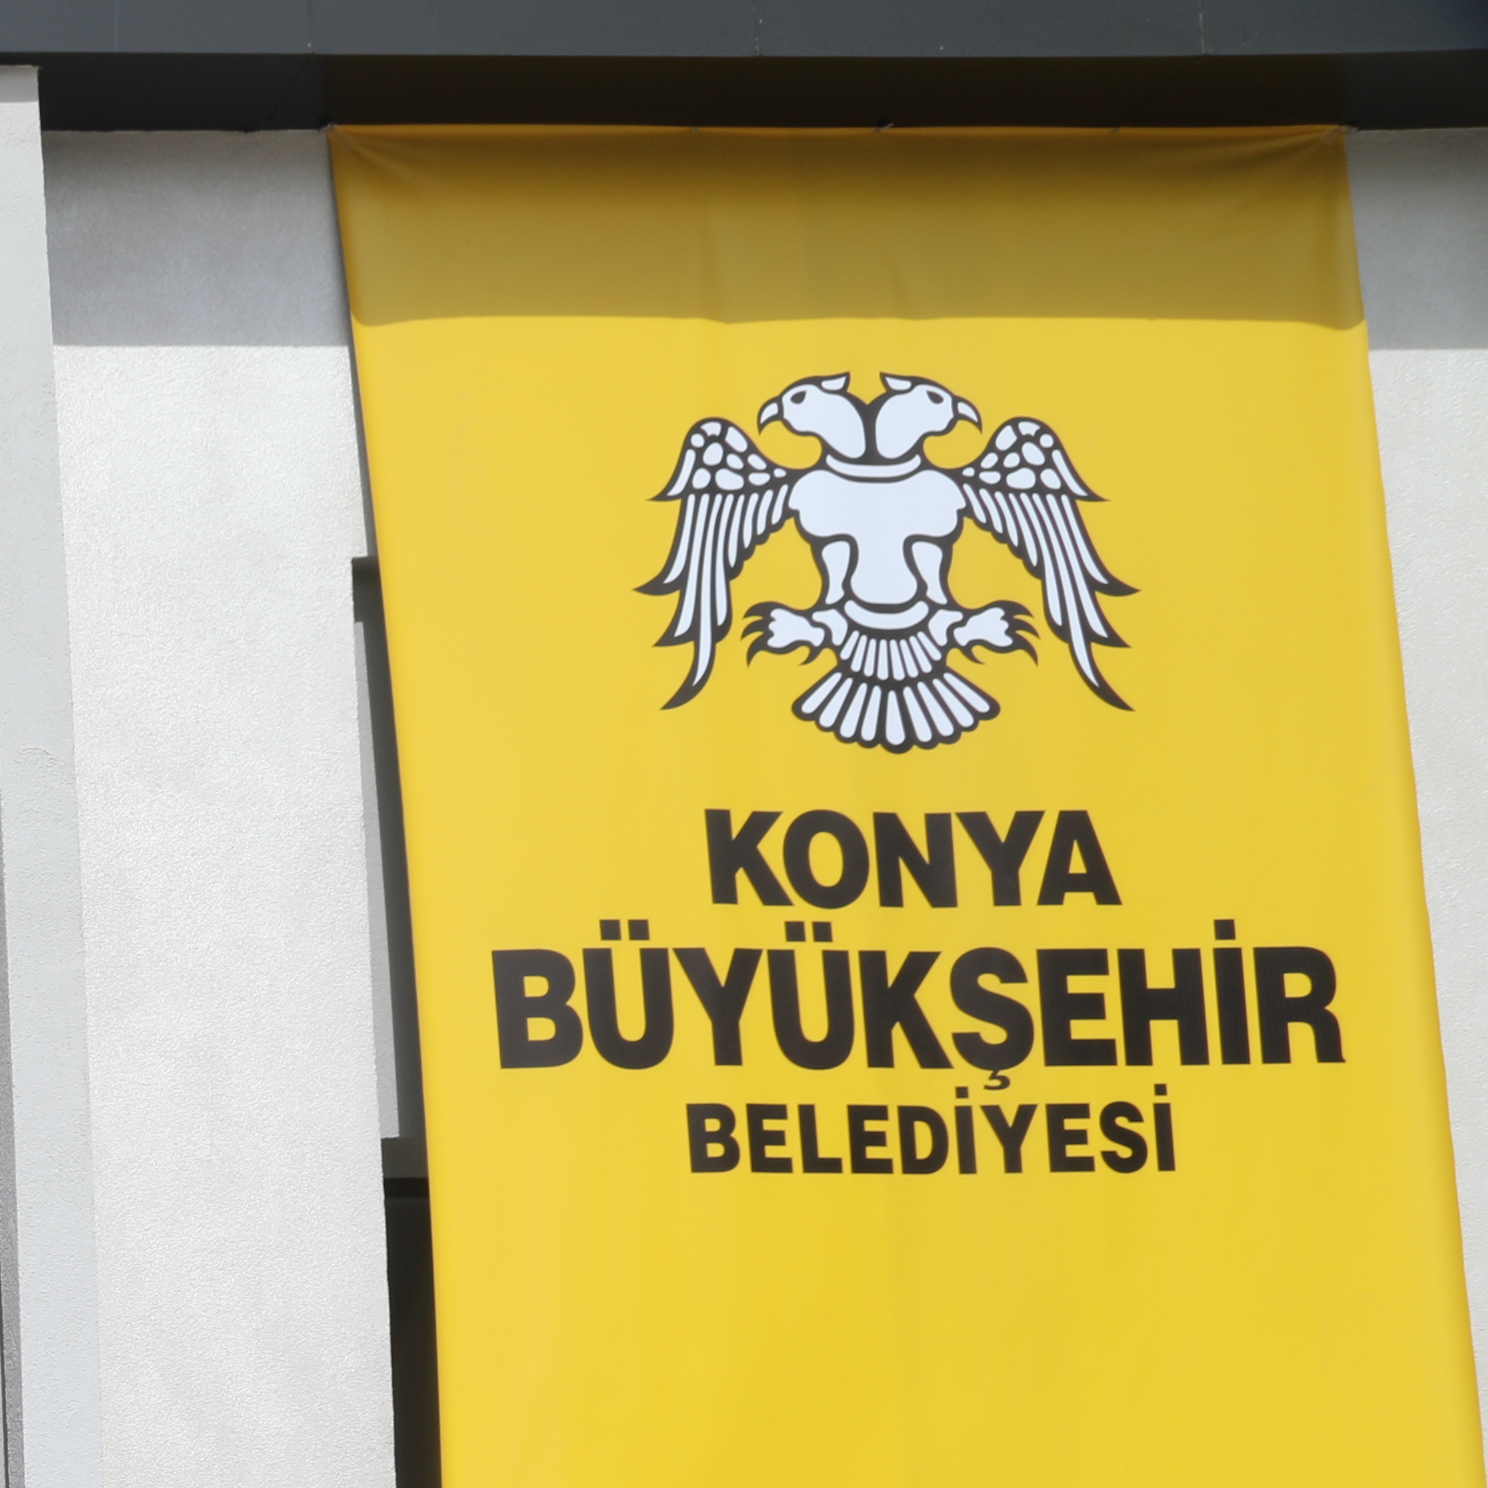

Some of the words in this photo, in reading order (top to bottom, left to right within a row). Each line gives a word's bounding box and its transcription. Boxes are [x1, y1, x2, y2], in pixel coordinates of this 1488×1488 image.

[704, 809, 1122, 910] KONYA
[491, 918, 1346, 1091] BÜYÜKŞEHİR
[685, 1084, 1177, 1175] BELEDİYESİ
